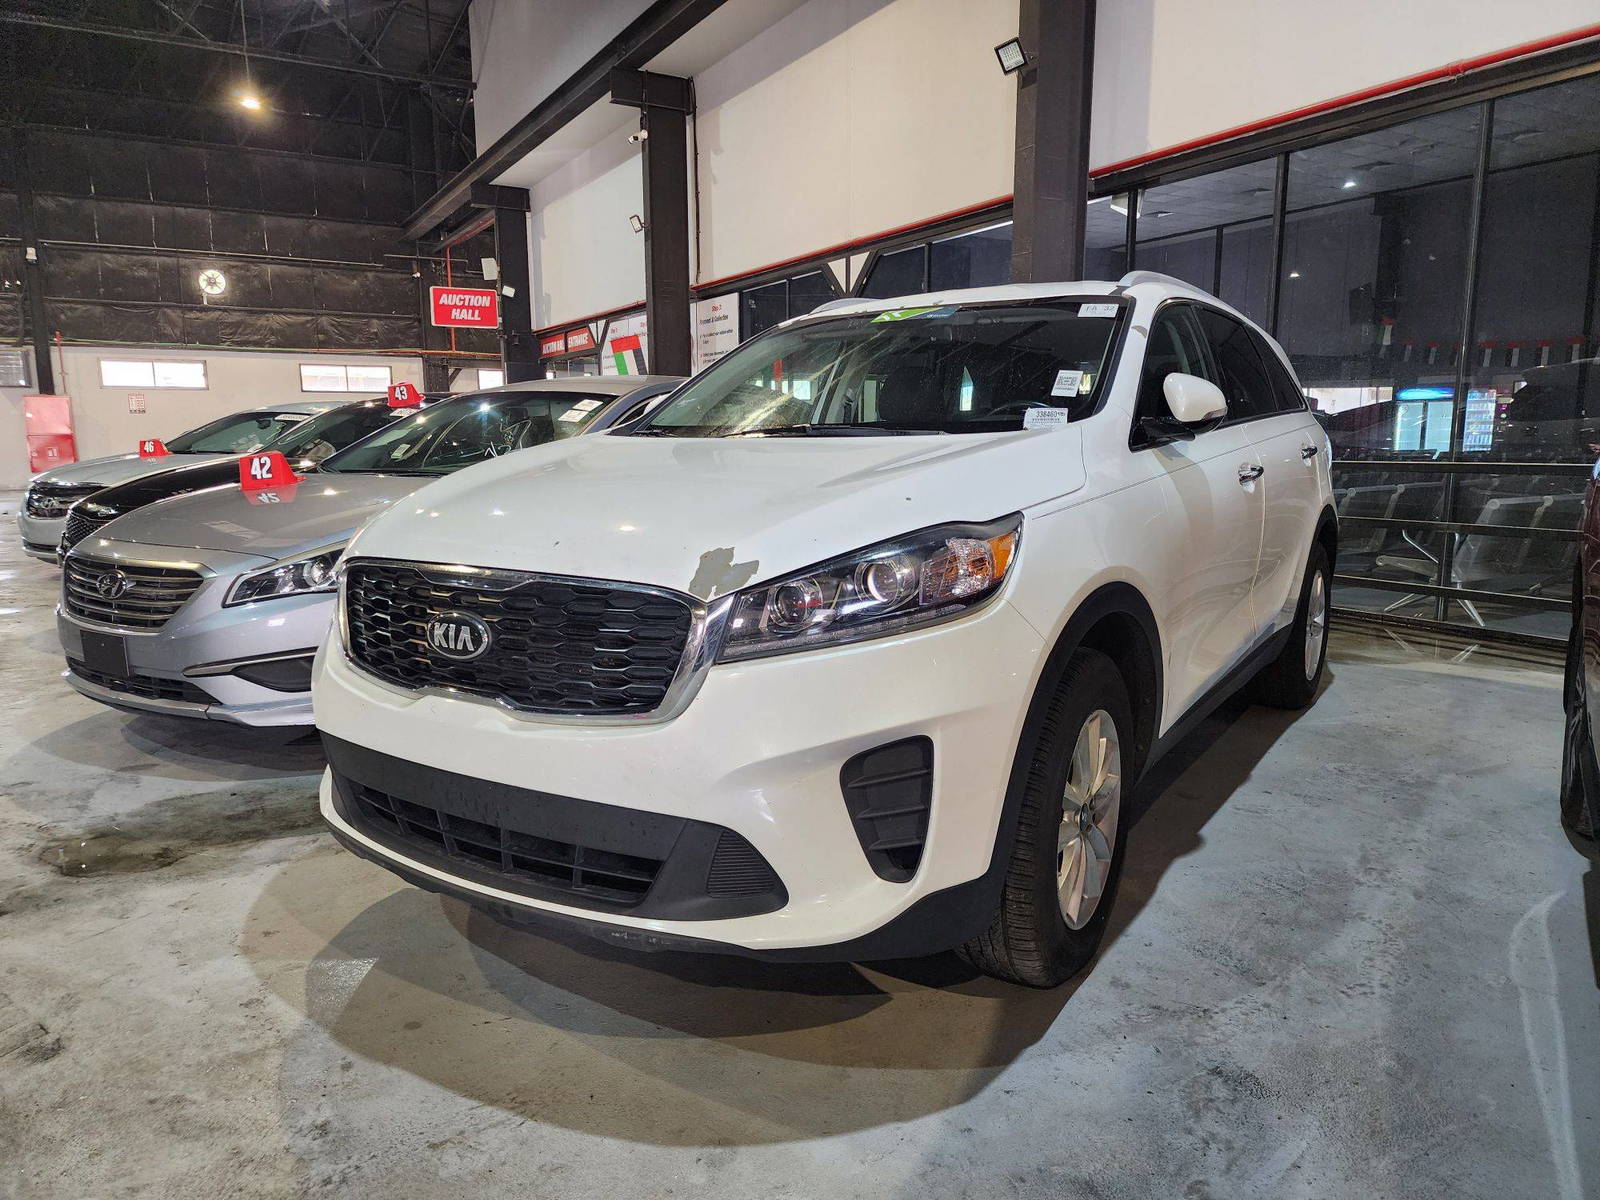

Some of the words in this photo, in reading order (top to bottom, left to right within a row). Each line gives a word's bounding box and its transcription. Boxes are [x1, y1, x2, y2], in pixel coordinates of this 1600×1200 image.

[439, 293, 491, 307] AUCTION
[451, 308, 481, 320] HALL
[395, 385, 408, 400] 43
[144, 441, 154, 453] 46
[251, 456, 272, 480] 42
[433, 621, 475, 651] KIA
